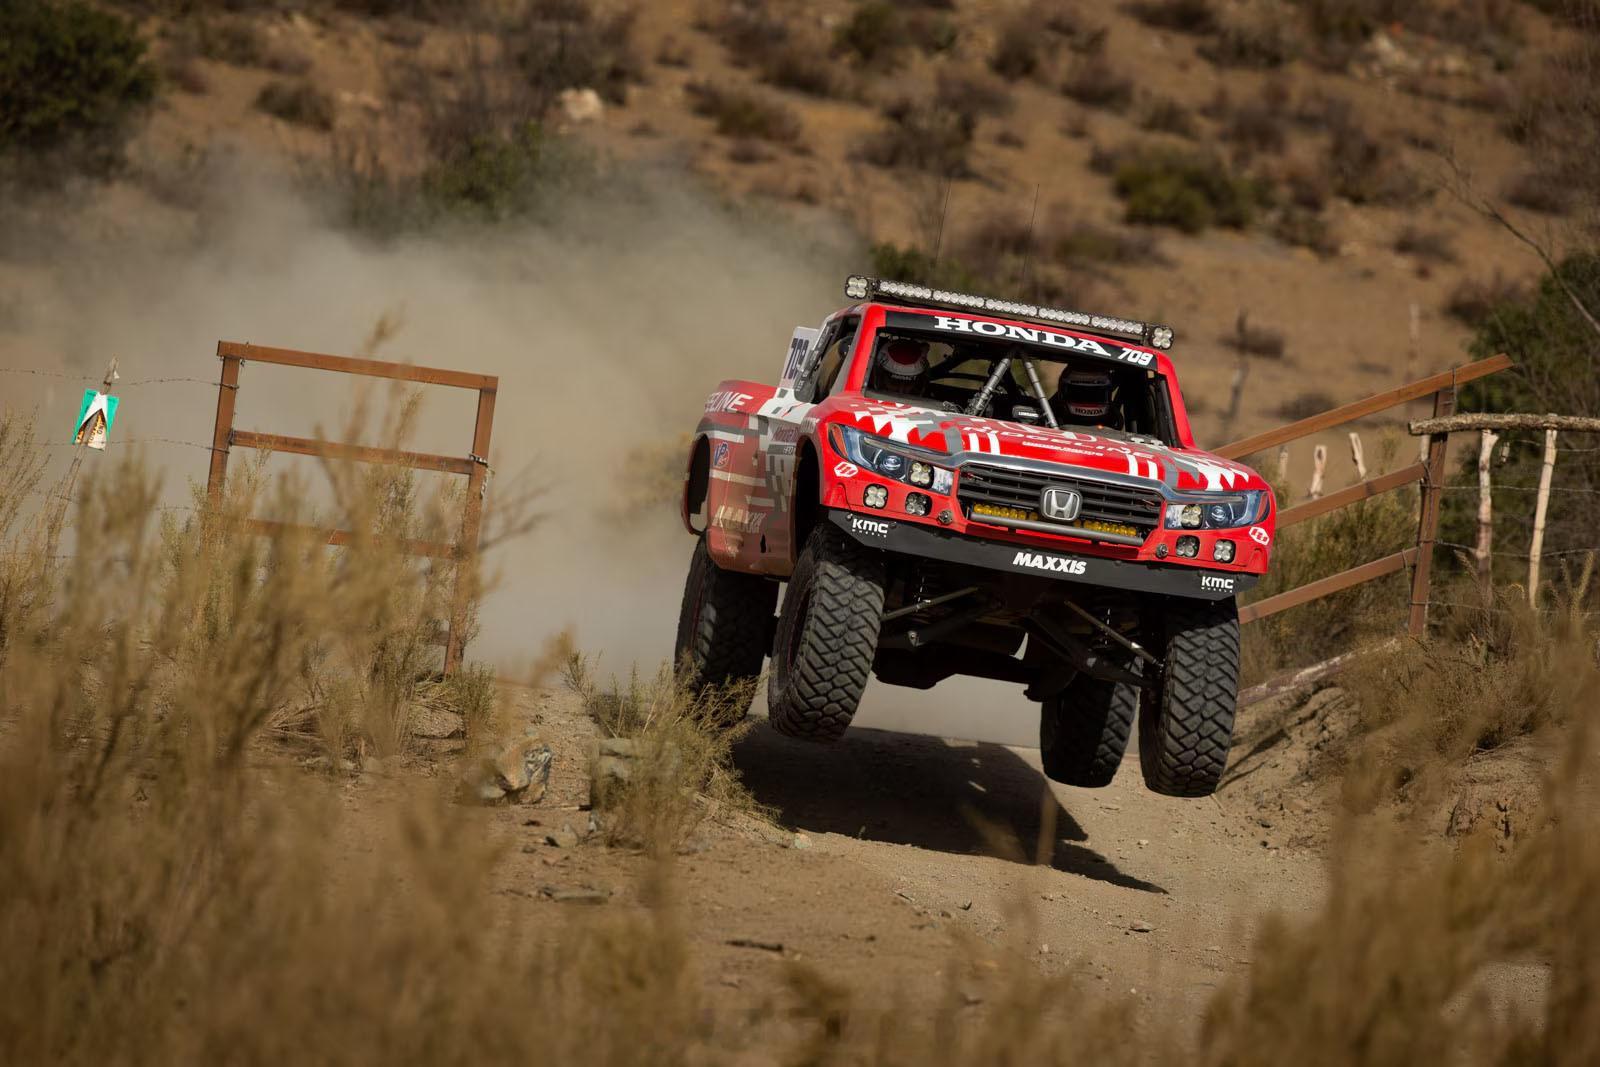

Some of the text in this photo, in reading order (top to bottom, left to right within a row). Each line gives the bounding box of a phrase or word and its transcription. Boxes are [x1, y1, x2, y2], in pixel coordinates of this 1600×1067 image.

[934, 316, 1154, 366] HONDA 709
[852, 518, 889, 534] KMC
[1013, 551, 1087, 575] MAXXIS
[1201, 576, 1234, 590] KMC
